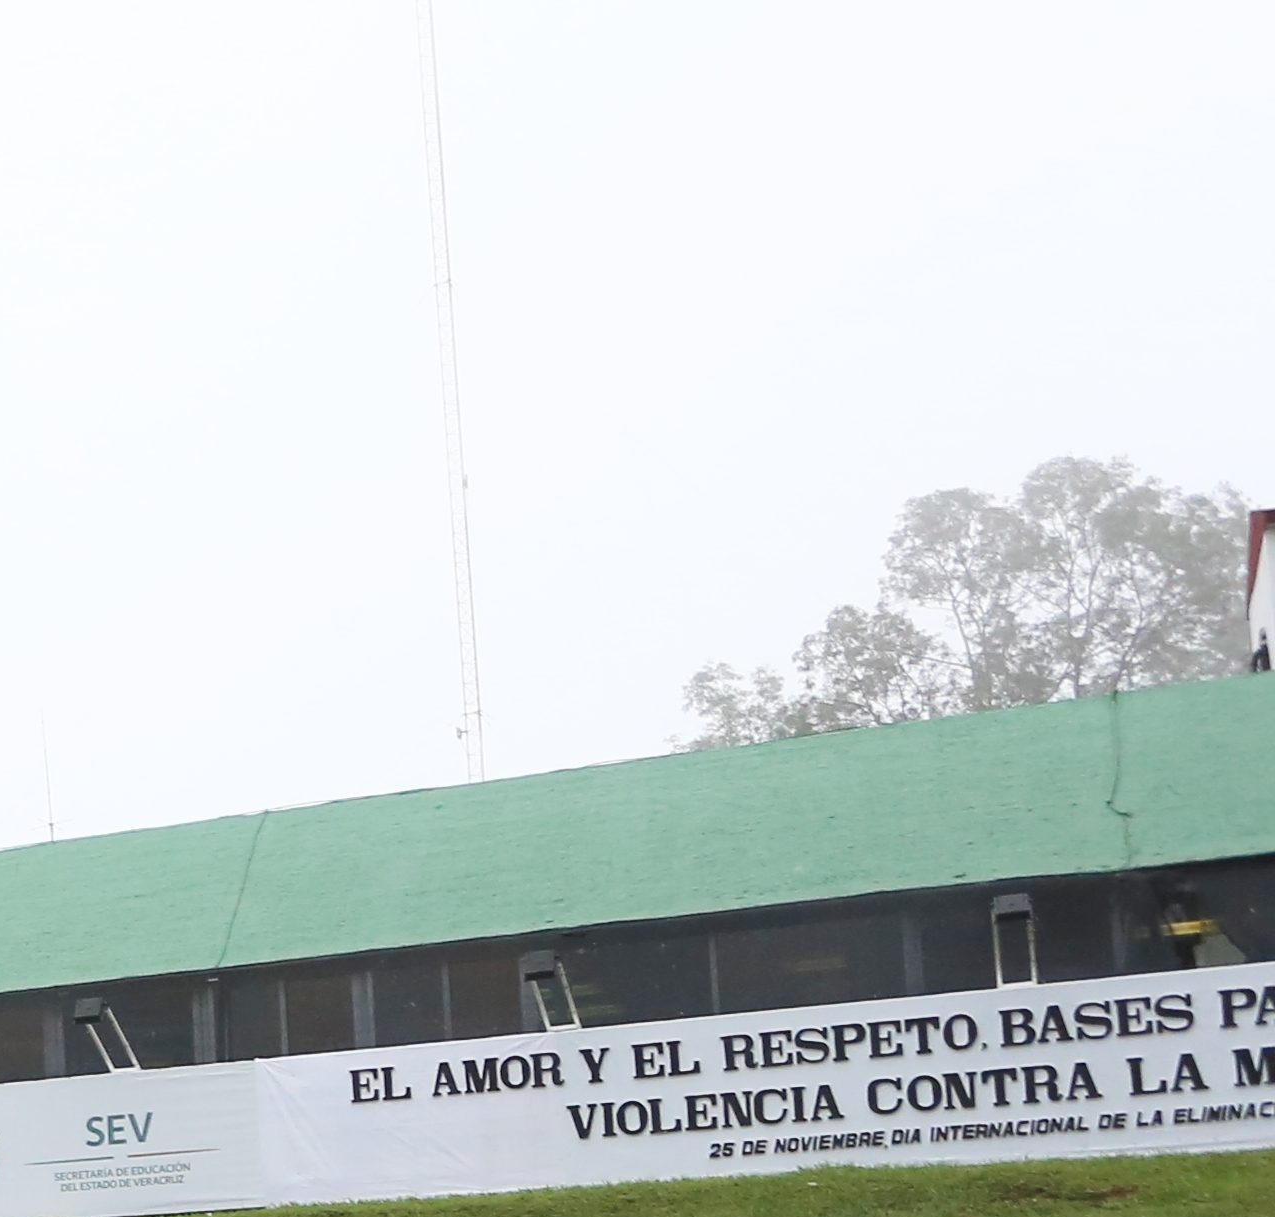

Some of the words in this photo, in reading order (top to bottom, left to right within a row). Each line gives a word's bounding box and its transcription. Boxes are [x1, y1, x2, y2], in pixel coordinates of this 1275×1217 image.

[349, 1067, 411, 1103] EL
[432, 1052, 565, 1096] AMOR
[578, 1047, 610, 1083] Y
[632, 1041, 701, 1079] EL
[720, 1014, 989, 1071] RESPETO,
[998, 993, 1194, 1048] BASES
[566, 1085, 845, 1139] VIOLENCIA
[867, 1062, 1103, 1115] CONTRA
[1126, 1053, 1209, 1096] LA
[85, 1112, 154, 1147] SEV
[709, 1142, 735, 1159] 25
[742, 1139, 768, 1156] DE
[774, 1131, 889, 1153] NOVIEMBRE,
[891, 1128, 921, 1146] DIA
[930, 1116, 1089, 1142] INTERNACIONAL
[1098, 1113, 1127, 1129] DE
[1136, 1109, 1163, 1127] LA
[54, 1167, 114, 1181] SECRETARÍA
[116, 1167, 130, 1177] DE
[131, 1162, 191, 1176] EDUCACIÓN
[60, 1182, 79, 1192] DEL
[80, 1179, 118, 1190] ESTADO
[119, 1178, 132, 1188] DE
[133, 1175, 185, 1187] VERACRUZ
